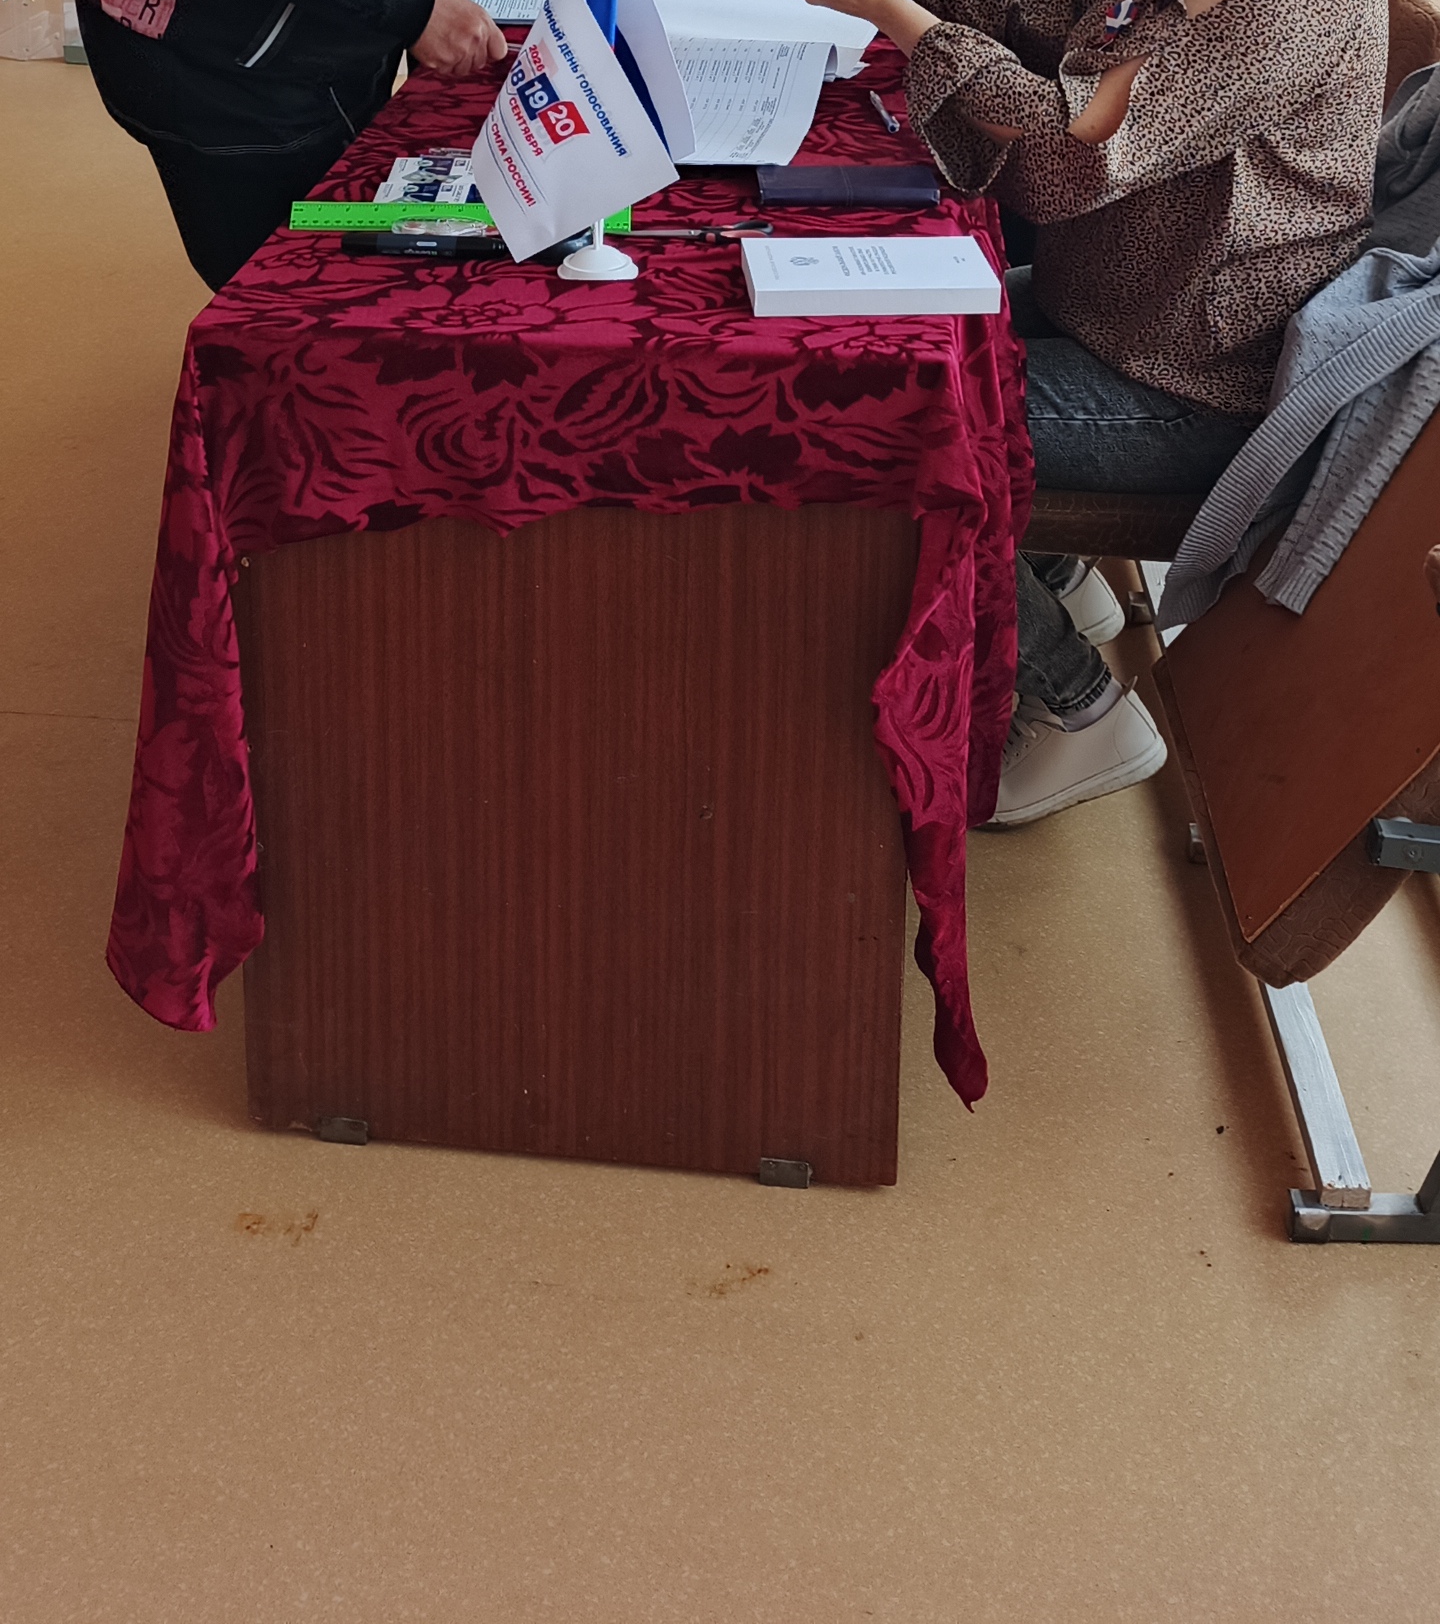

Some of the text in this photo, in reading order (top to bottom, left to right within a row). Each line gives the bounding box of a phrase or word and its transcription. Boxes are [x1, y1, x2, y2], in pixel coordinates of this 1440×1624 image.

[528, 44, 546, 72] 2026
[508, 96, 544, 157] СЕНТЯБРЯ
[510, 60, 576, 137] 18 19 20
[557, 43, 579, 74] ДЕНЬ
[575, 73, 628, 157] ГОЛОСОВАНИЯ
[491, 122, 508, 156] СИЛА
[503, 156, 537, 207] РОССИИ!
